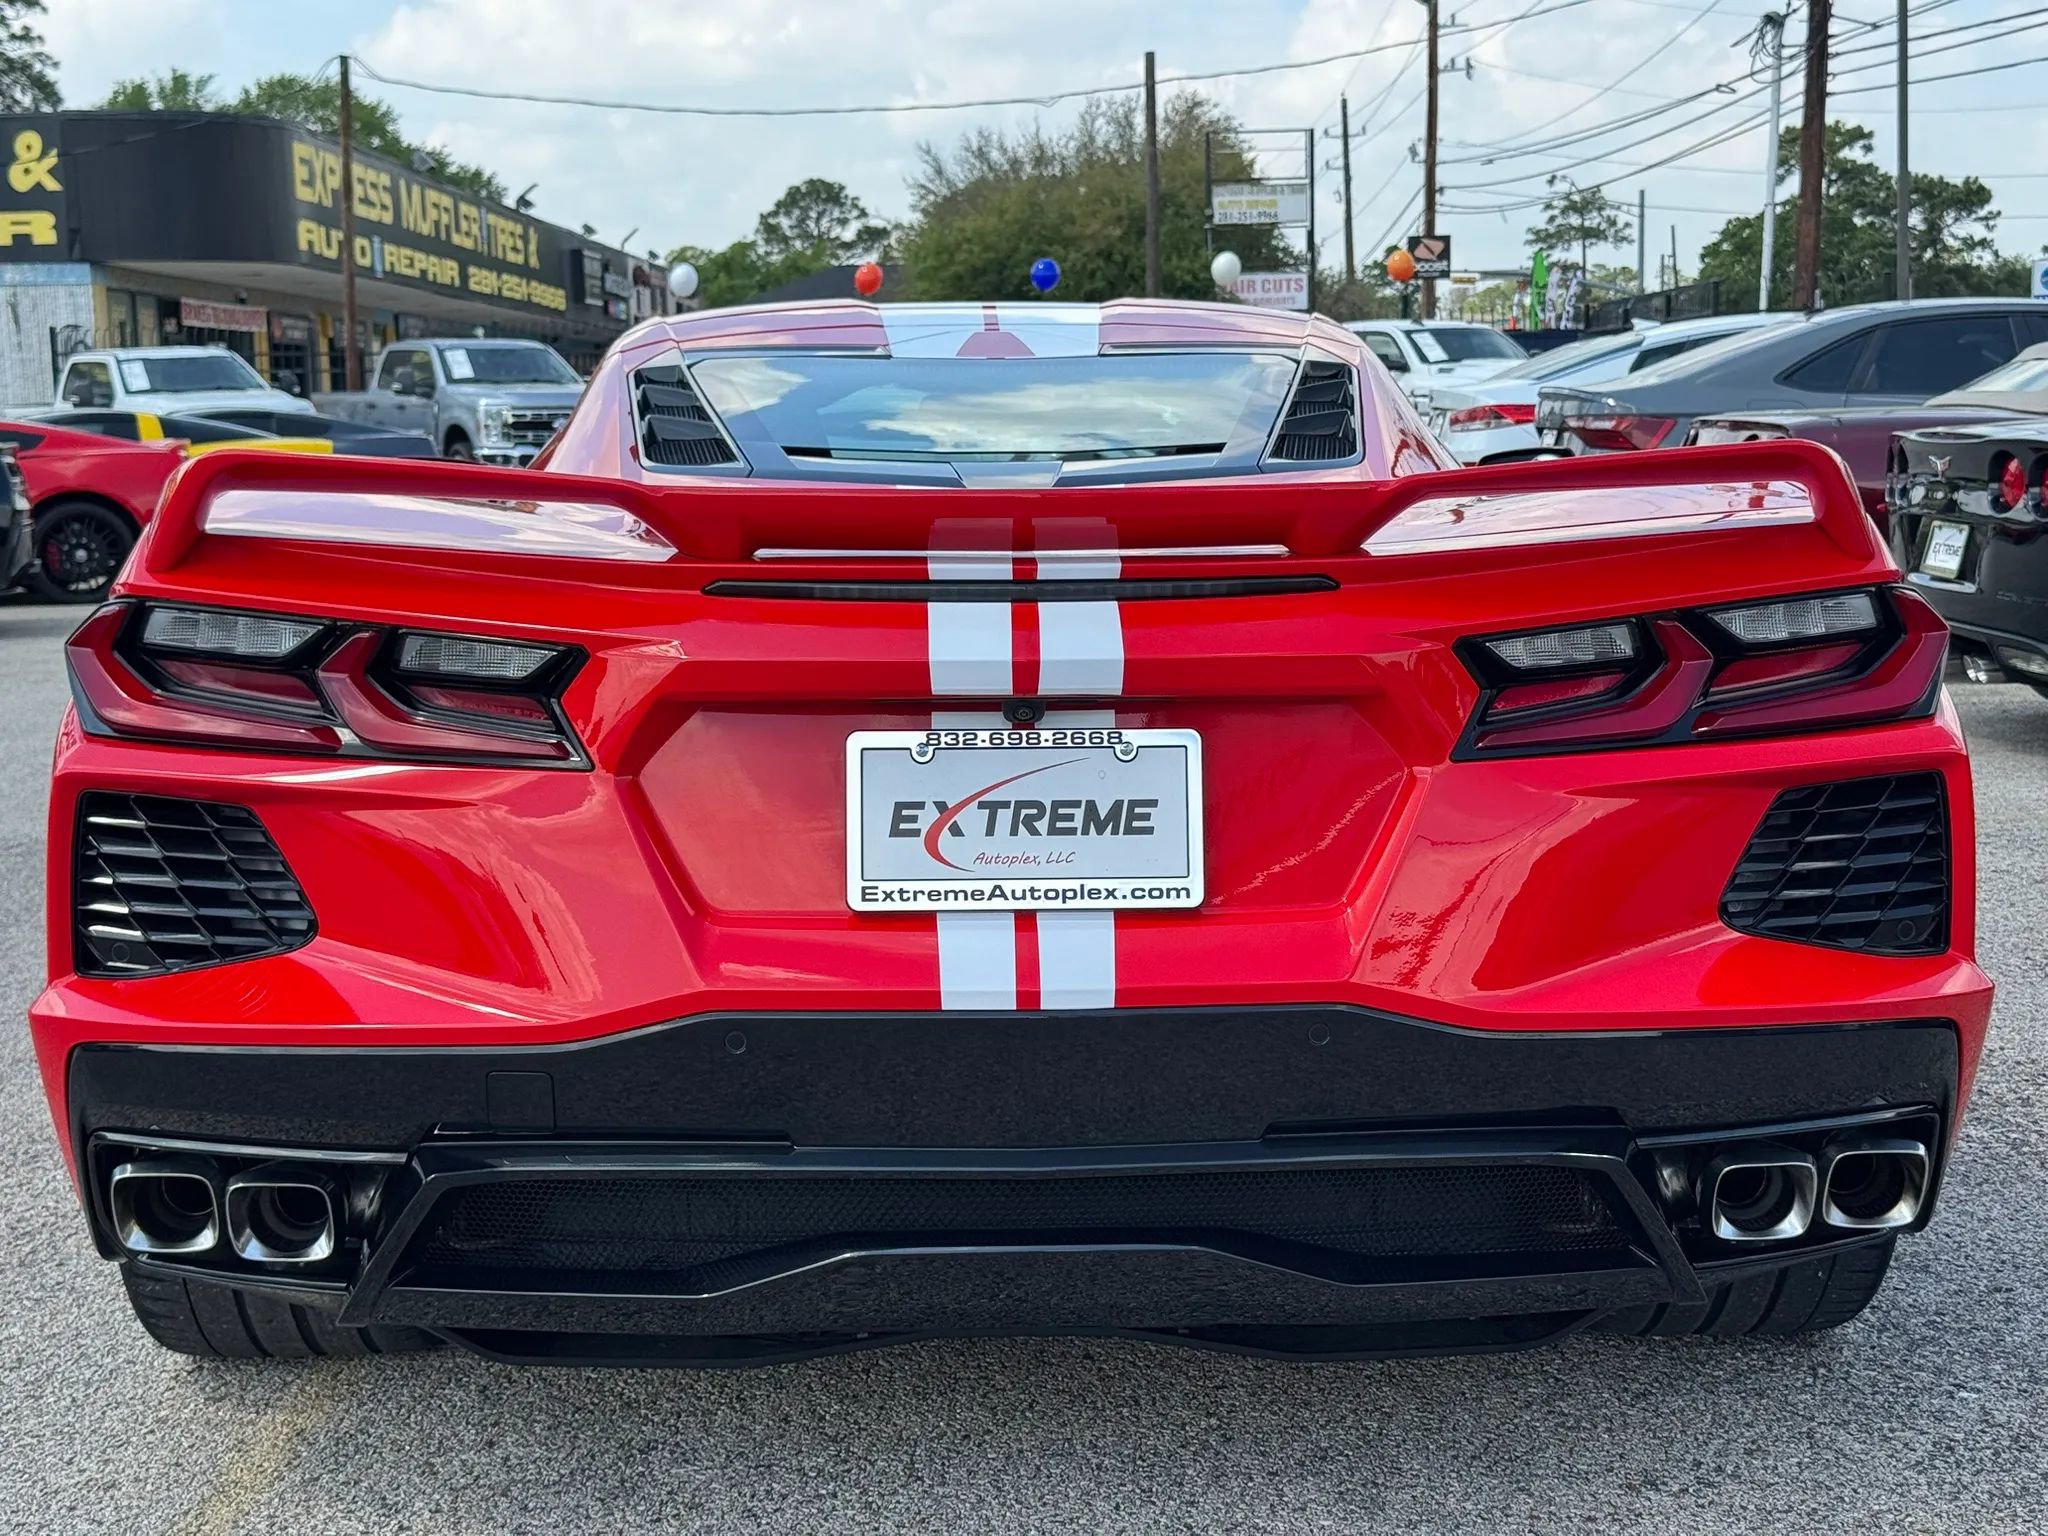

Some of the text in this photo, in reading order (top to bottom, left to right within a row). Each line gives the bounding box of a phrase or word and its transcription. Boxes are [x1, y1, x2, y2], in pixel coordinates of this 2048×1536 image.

[8, 129, 63, 193] &
[292, 141, 394, 225] EXPESS
[400, 178, 485, 253] MUFFLER
[297, 218, 373, 268] AUO
[384, 242, 461, 288] REPAIR
[1414, 260, 1449, 272] oost
[1261, 278, 1304, 294] CUTS
[925, 731, 1124, 747] 832-698-2668
[889, 798, 1159, 838] EXTREME
[973, 851, 1076, 867] Autoplex, LLC
[861, 883, 1192, 904] ExtremeAutoplex.com
